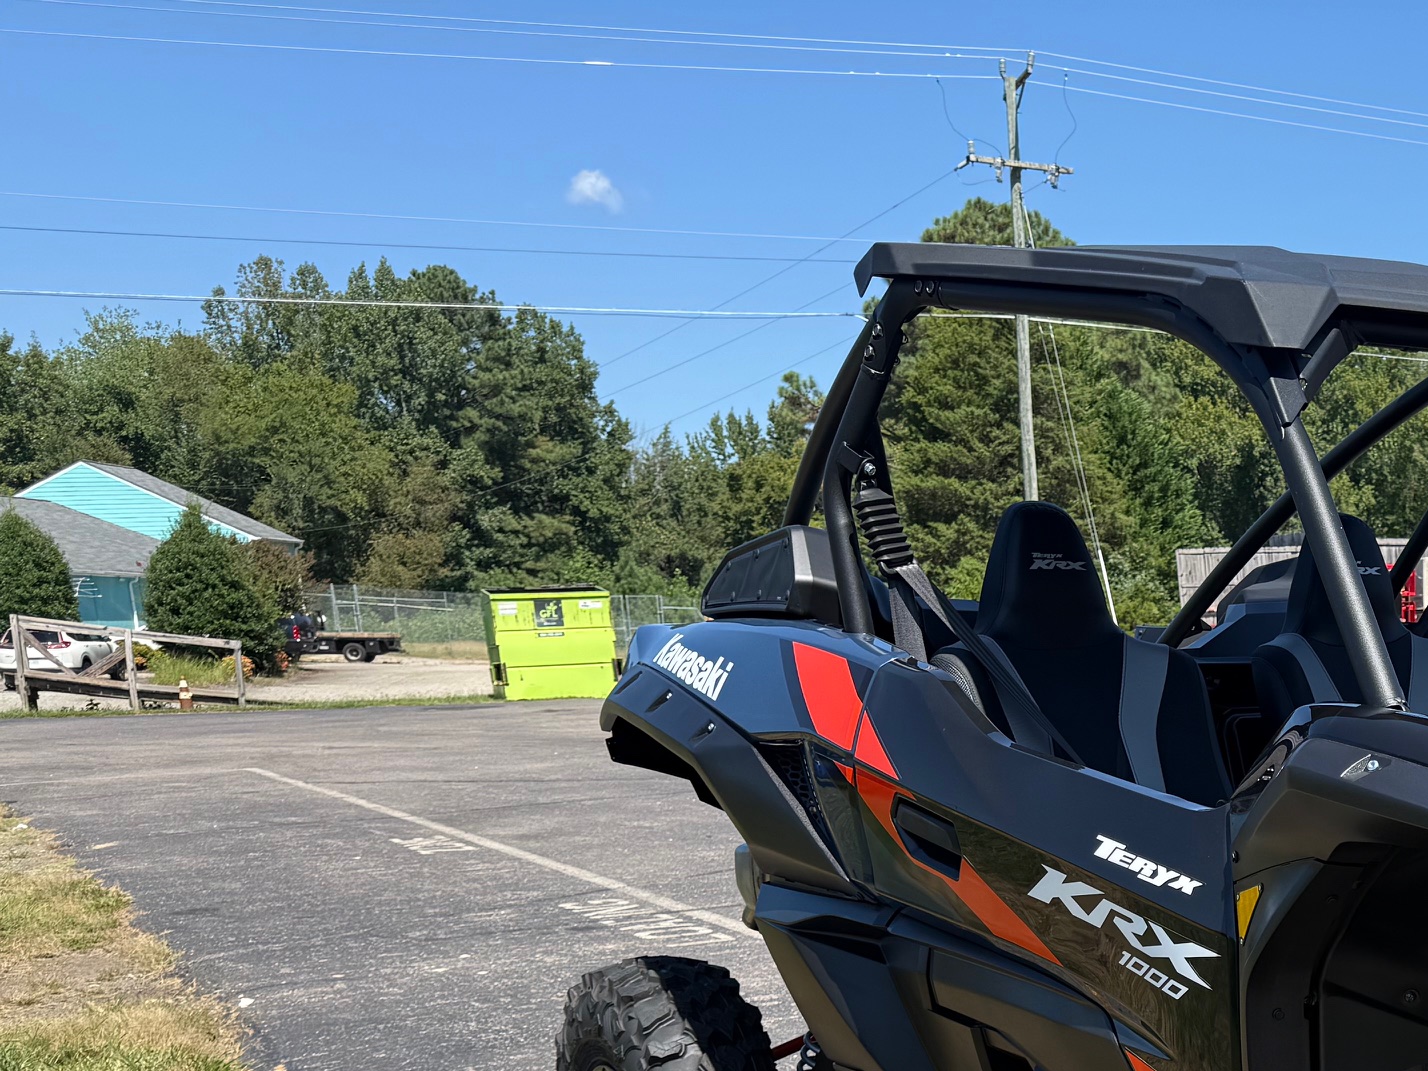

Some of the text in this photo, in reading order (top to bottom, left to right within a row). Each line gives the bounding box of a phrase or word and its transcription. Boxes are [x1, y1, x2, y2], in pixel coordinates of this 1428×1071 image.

[1029, 559, 1087, 570] KRX
[653, 633, 734, 701] Kawasaki
[1094, 834, 1203, 896] TERYX
[1027, 864, 1221, 991] KRX
[1118, 951, 1189, 1000] 1000
